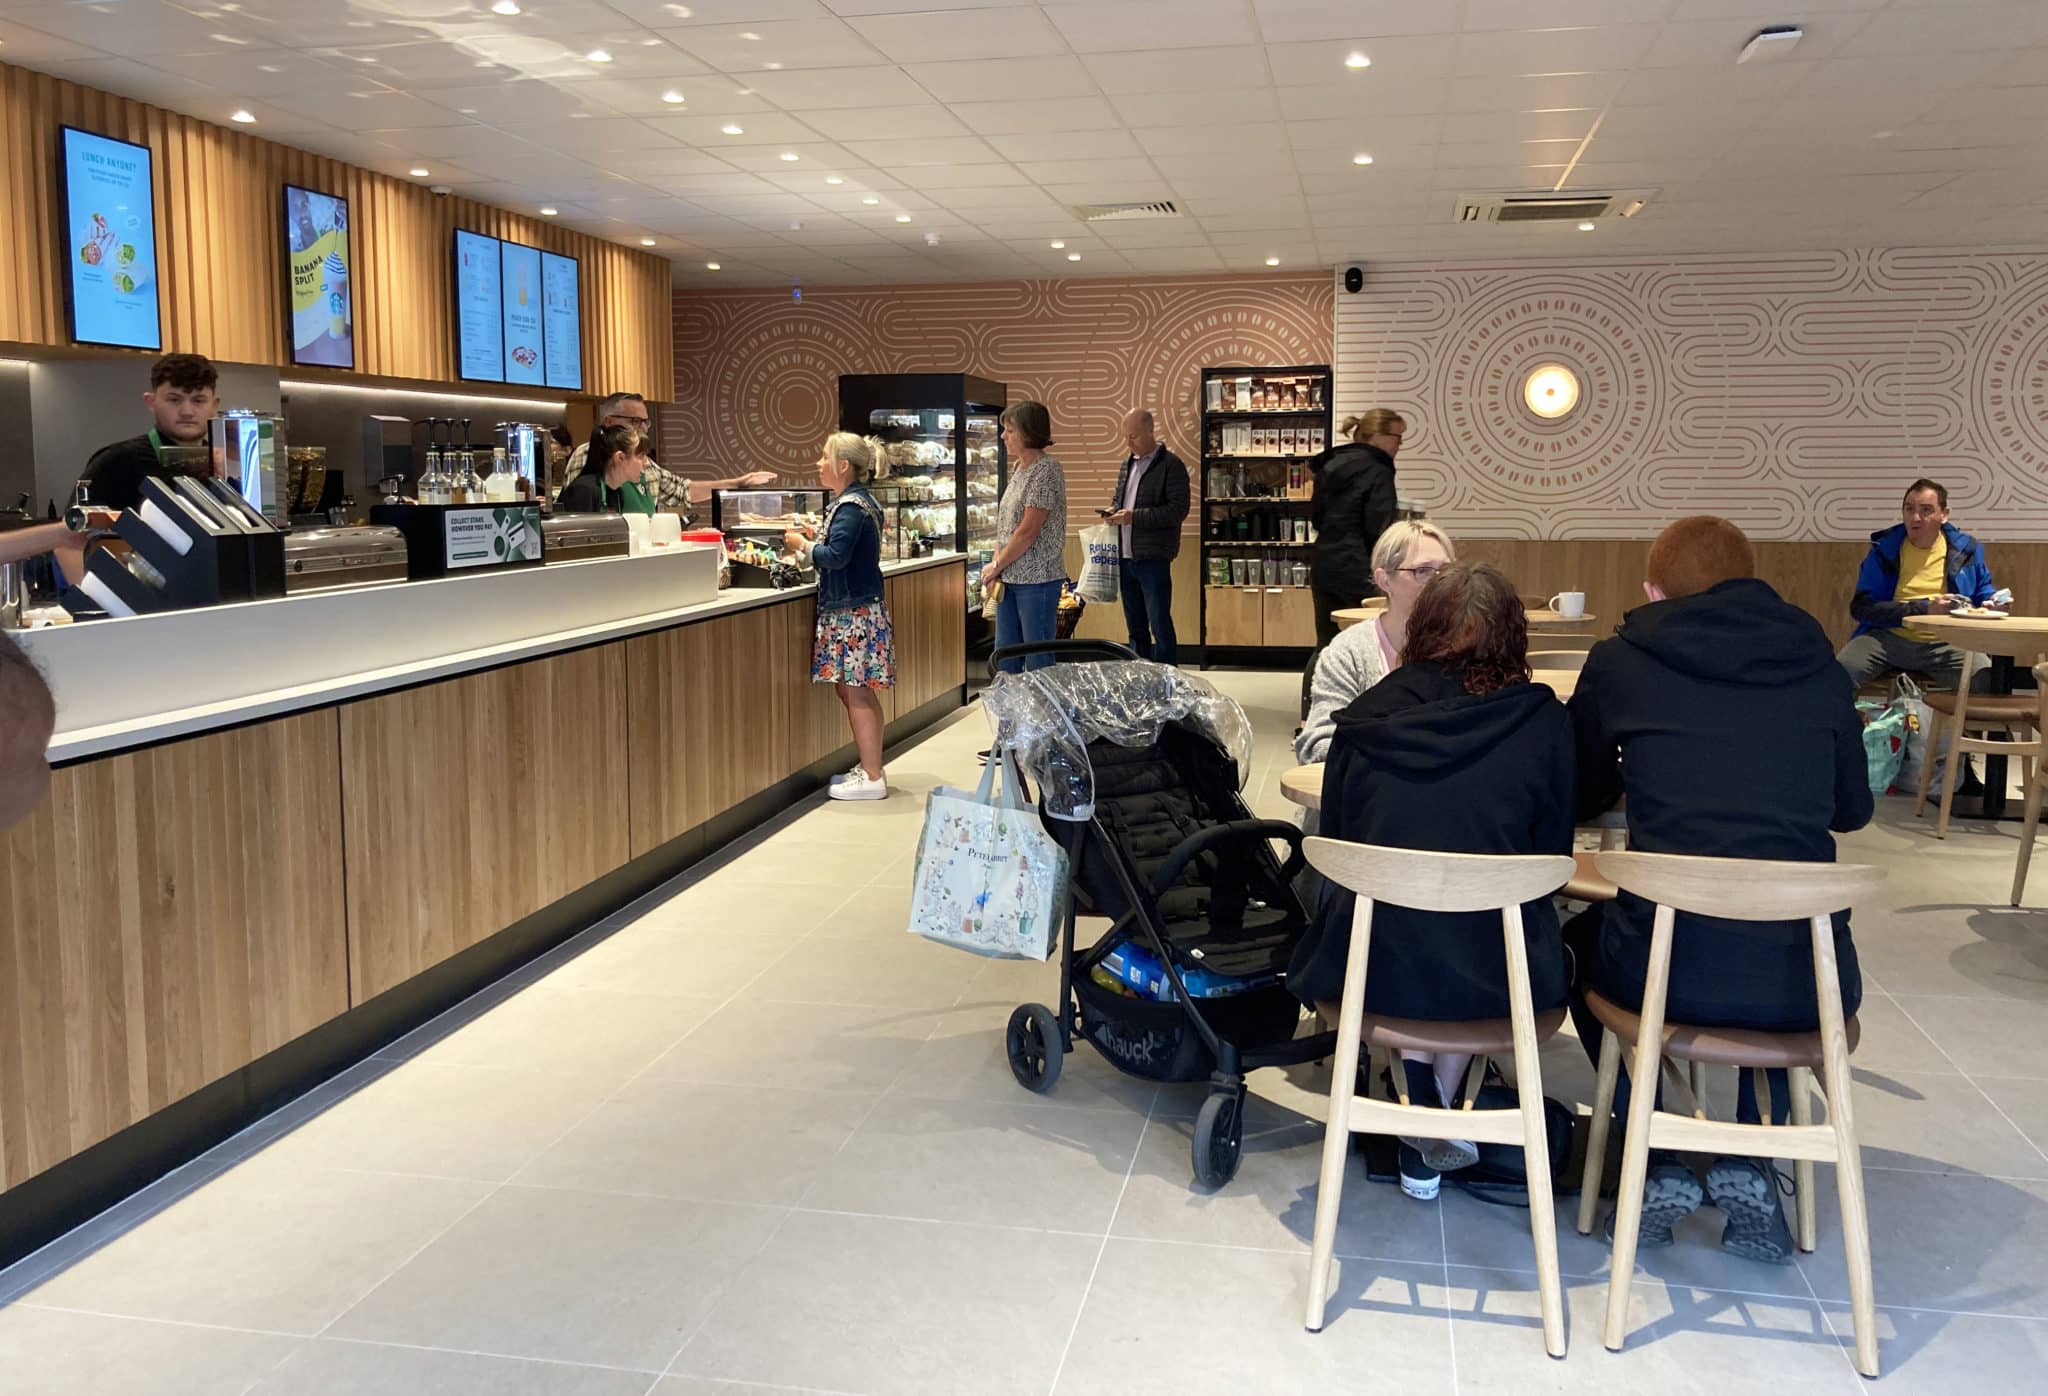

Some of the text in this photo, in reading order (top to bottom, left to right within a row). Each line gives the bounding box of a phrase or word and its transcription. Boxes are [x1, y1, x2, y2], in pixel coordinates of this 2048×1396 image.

[81, 151, 104, 165] LUNCH
[294, 255, 323, 275] BANANA
[294, 272, 314, 286] SPLIT
[451, 524, 474, 533] HOWEVER
[474, 523, 484, 531] YOU
[1106, 1026, 1155, 1066] hauck
